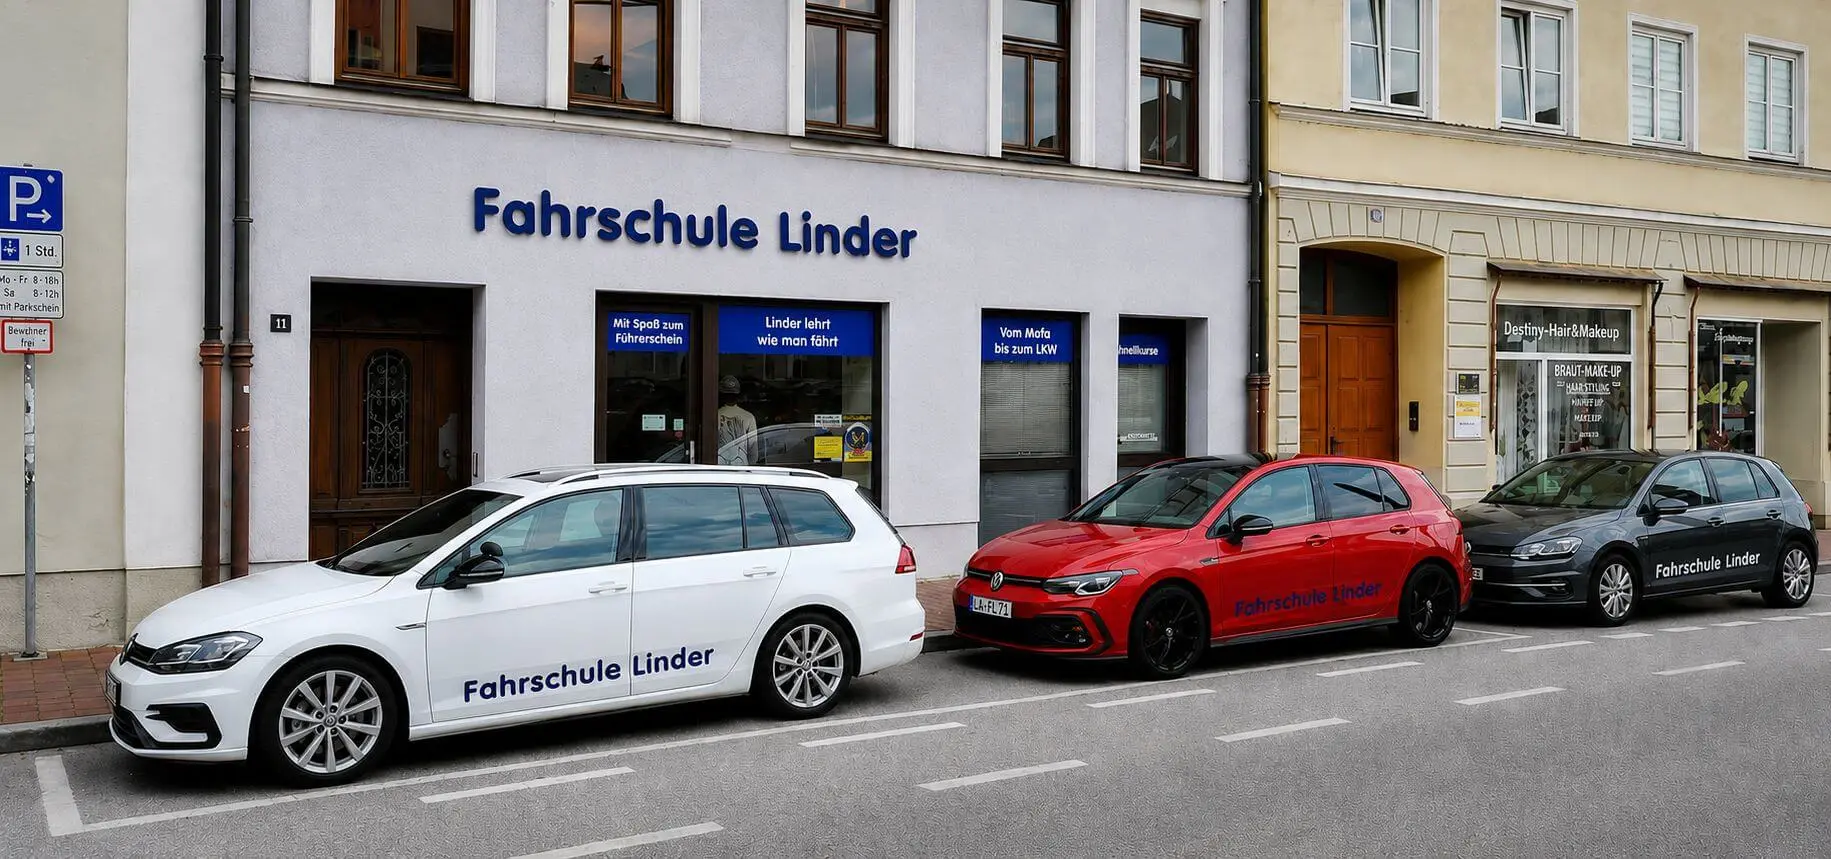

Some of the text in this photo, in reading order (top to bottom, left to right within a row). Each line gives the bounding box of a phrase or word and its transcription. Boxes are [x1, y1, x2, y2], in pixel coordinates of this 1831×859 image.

[10, 175, 42, 222] P
[474, 187, 918, 258] Fahrschule Linder
[25, 244, 57, 257] 1 Std.
[19, 275, 28, 283] Fr
[4, 287, 15, 298] Sa
[0, 302, 60, 313] mit Parkschein
[276, 318, 287, 329] 11
[613, 318, 684, 331] Mit Spaß zum
[765, 316, 831, 330] Linder lehrt
[999, 326, 1051, 339] Vom Mofa
[1504, 321, 1620, 341] Destiny-Hair&Makeup
[20, 338, 35, 348] frei
[615, 332, 683, 345] Führerschein
[757, 334, 839, 348] wie man fährt
[994, 342, 1058, 355] bis zum LKW
[1554, 364, 1622, 377] BRAUT-MAKE-UP
[1655, 551, 1761, 579] Fahrschule Linder
[1234, 581, 1383, 618] Fahrschule Linder
[464, 646, 715, 703] Fahrschule Linder
